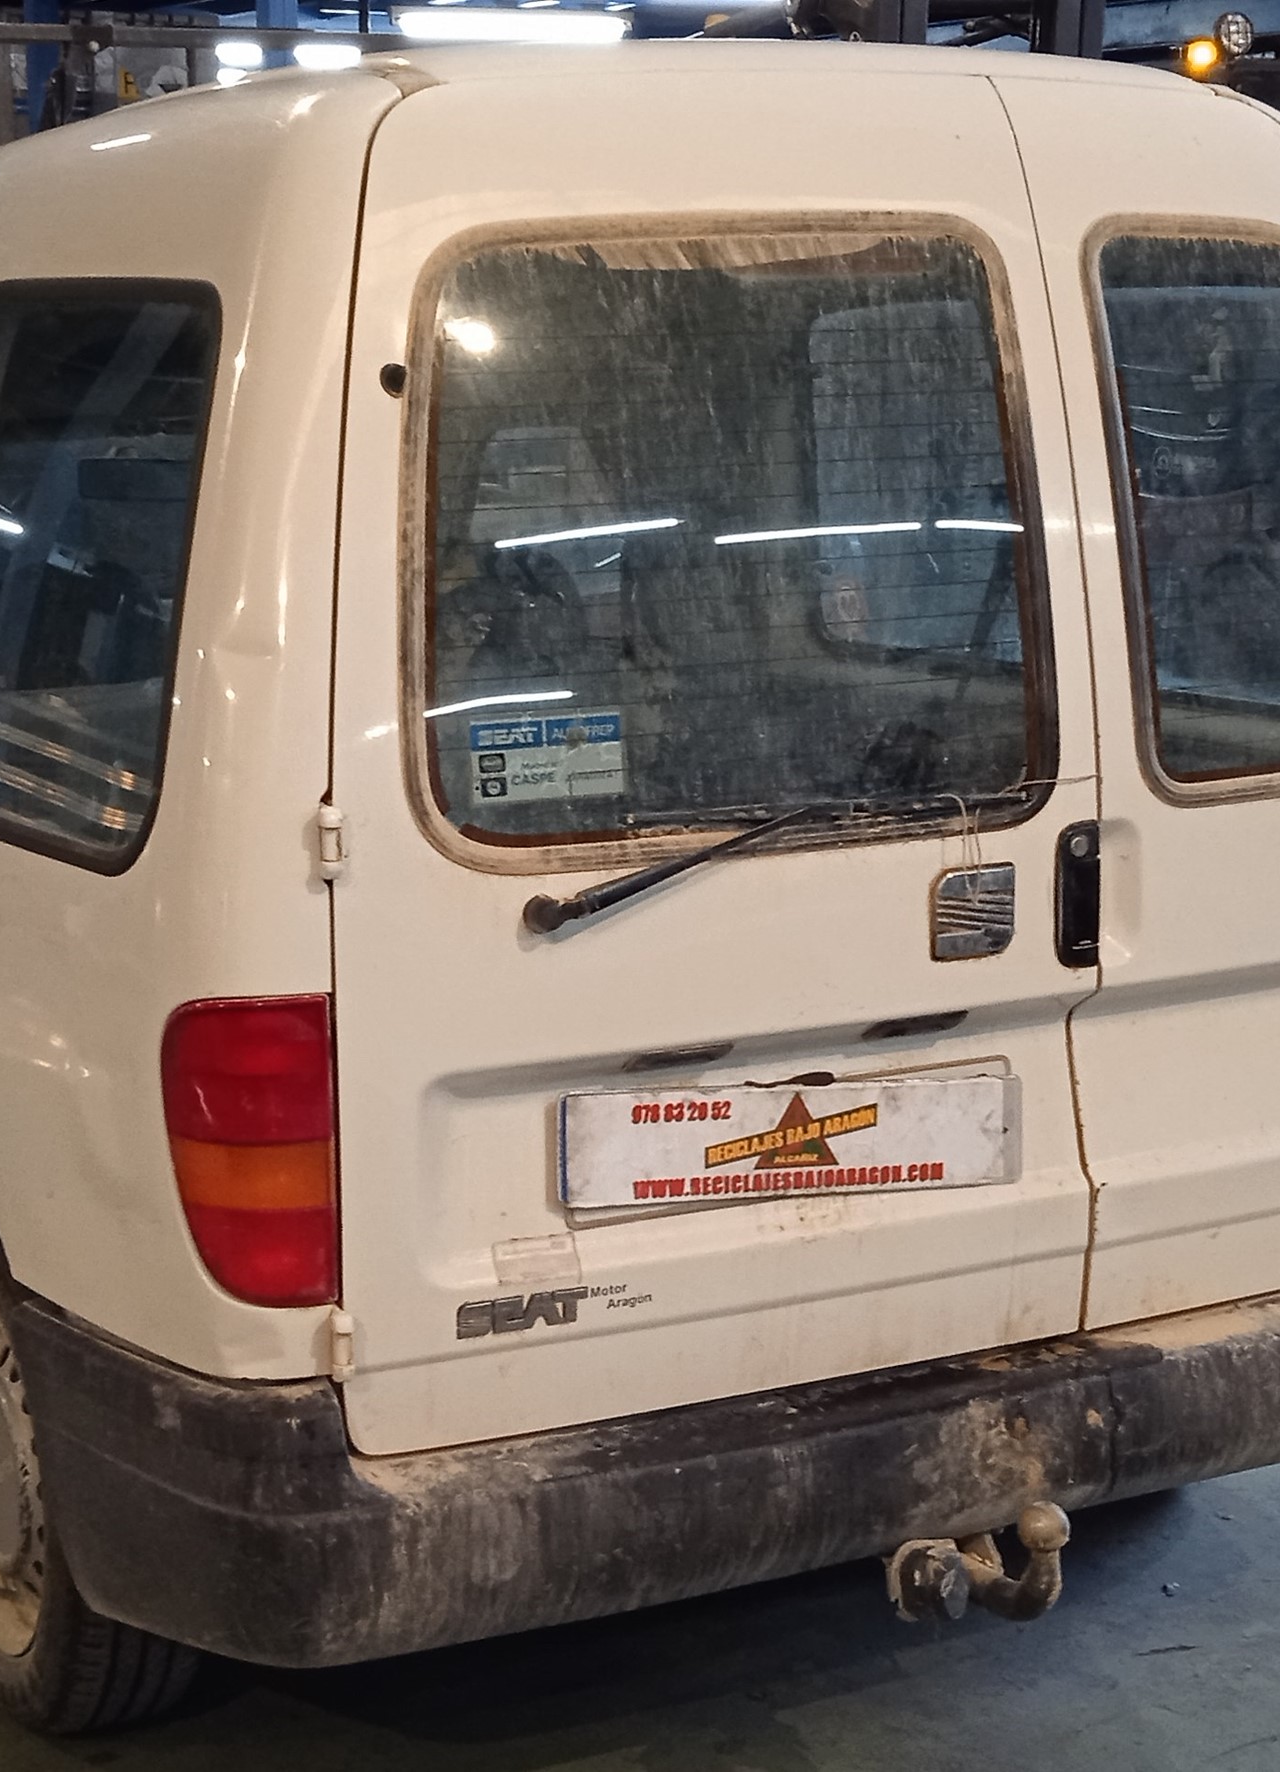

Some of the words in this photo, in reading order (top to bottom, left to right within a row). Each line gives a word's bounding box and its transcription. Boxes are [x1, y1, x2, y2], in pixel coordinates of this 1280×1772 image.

[477, 726, 538, 747] SEAT
[511, 772, 557, 786] CASPE
[631, 1103, 660, 1124] 978
[663, 1102, 685, 1122] 83
[687, 1101, 708, 1121] 20
[710, 1100, 732, 1120] 52
[708, 1130, 784, 1165] RECICLAJES
[785, 1118, 821, 1144] BAJO
[632, 1161, 945, 1199] WWW.RECICLAJESBAJOARAGON.COM
[456, 1286, 588, 1340] SEAT
[590, 1284, 627, 1299] Motor
